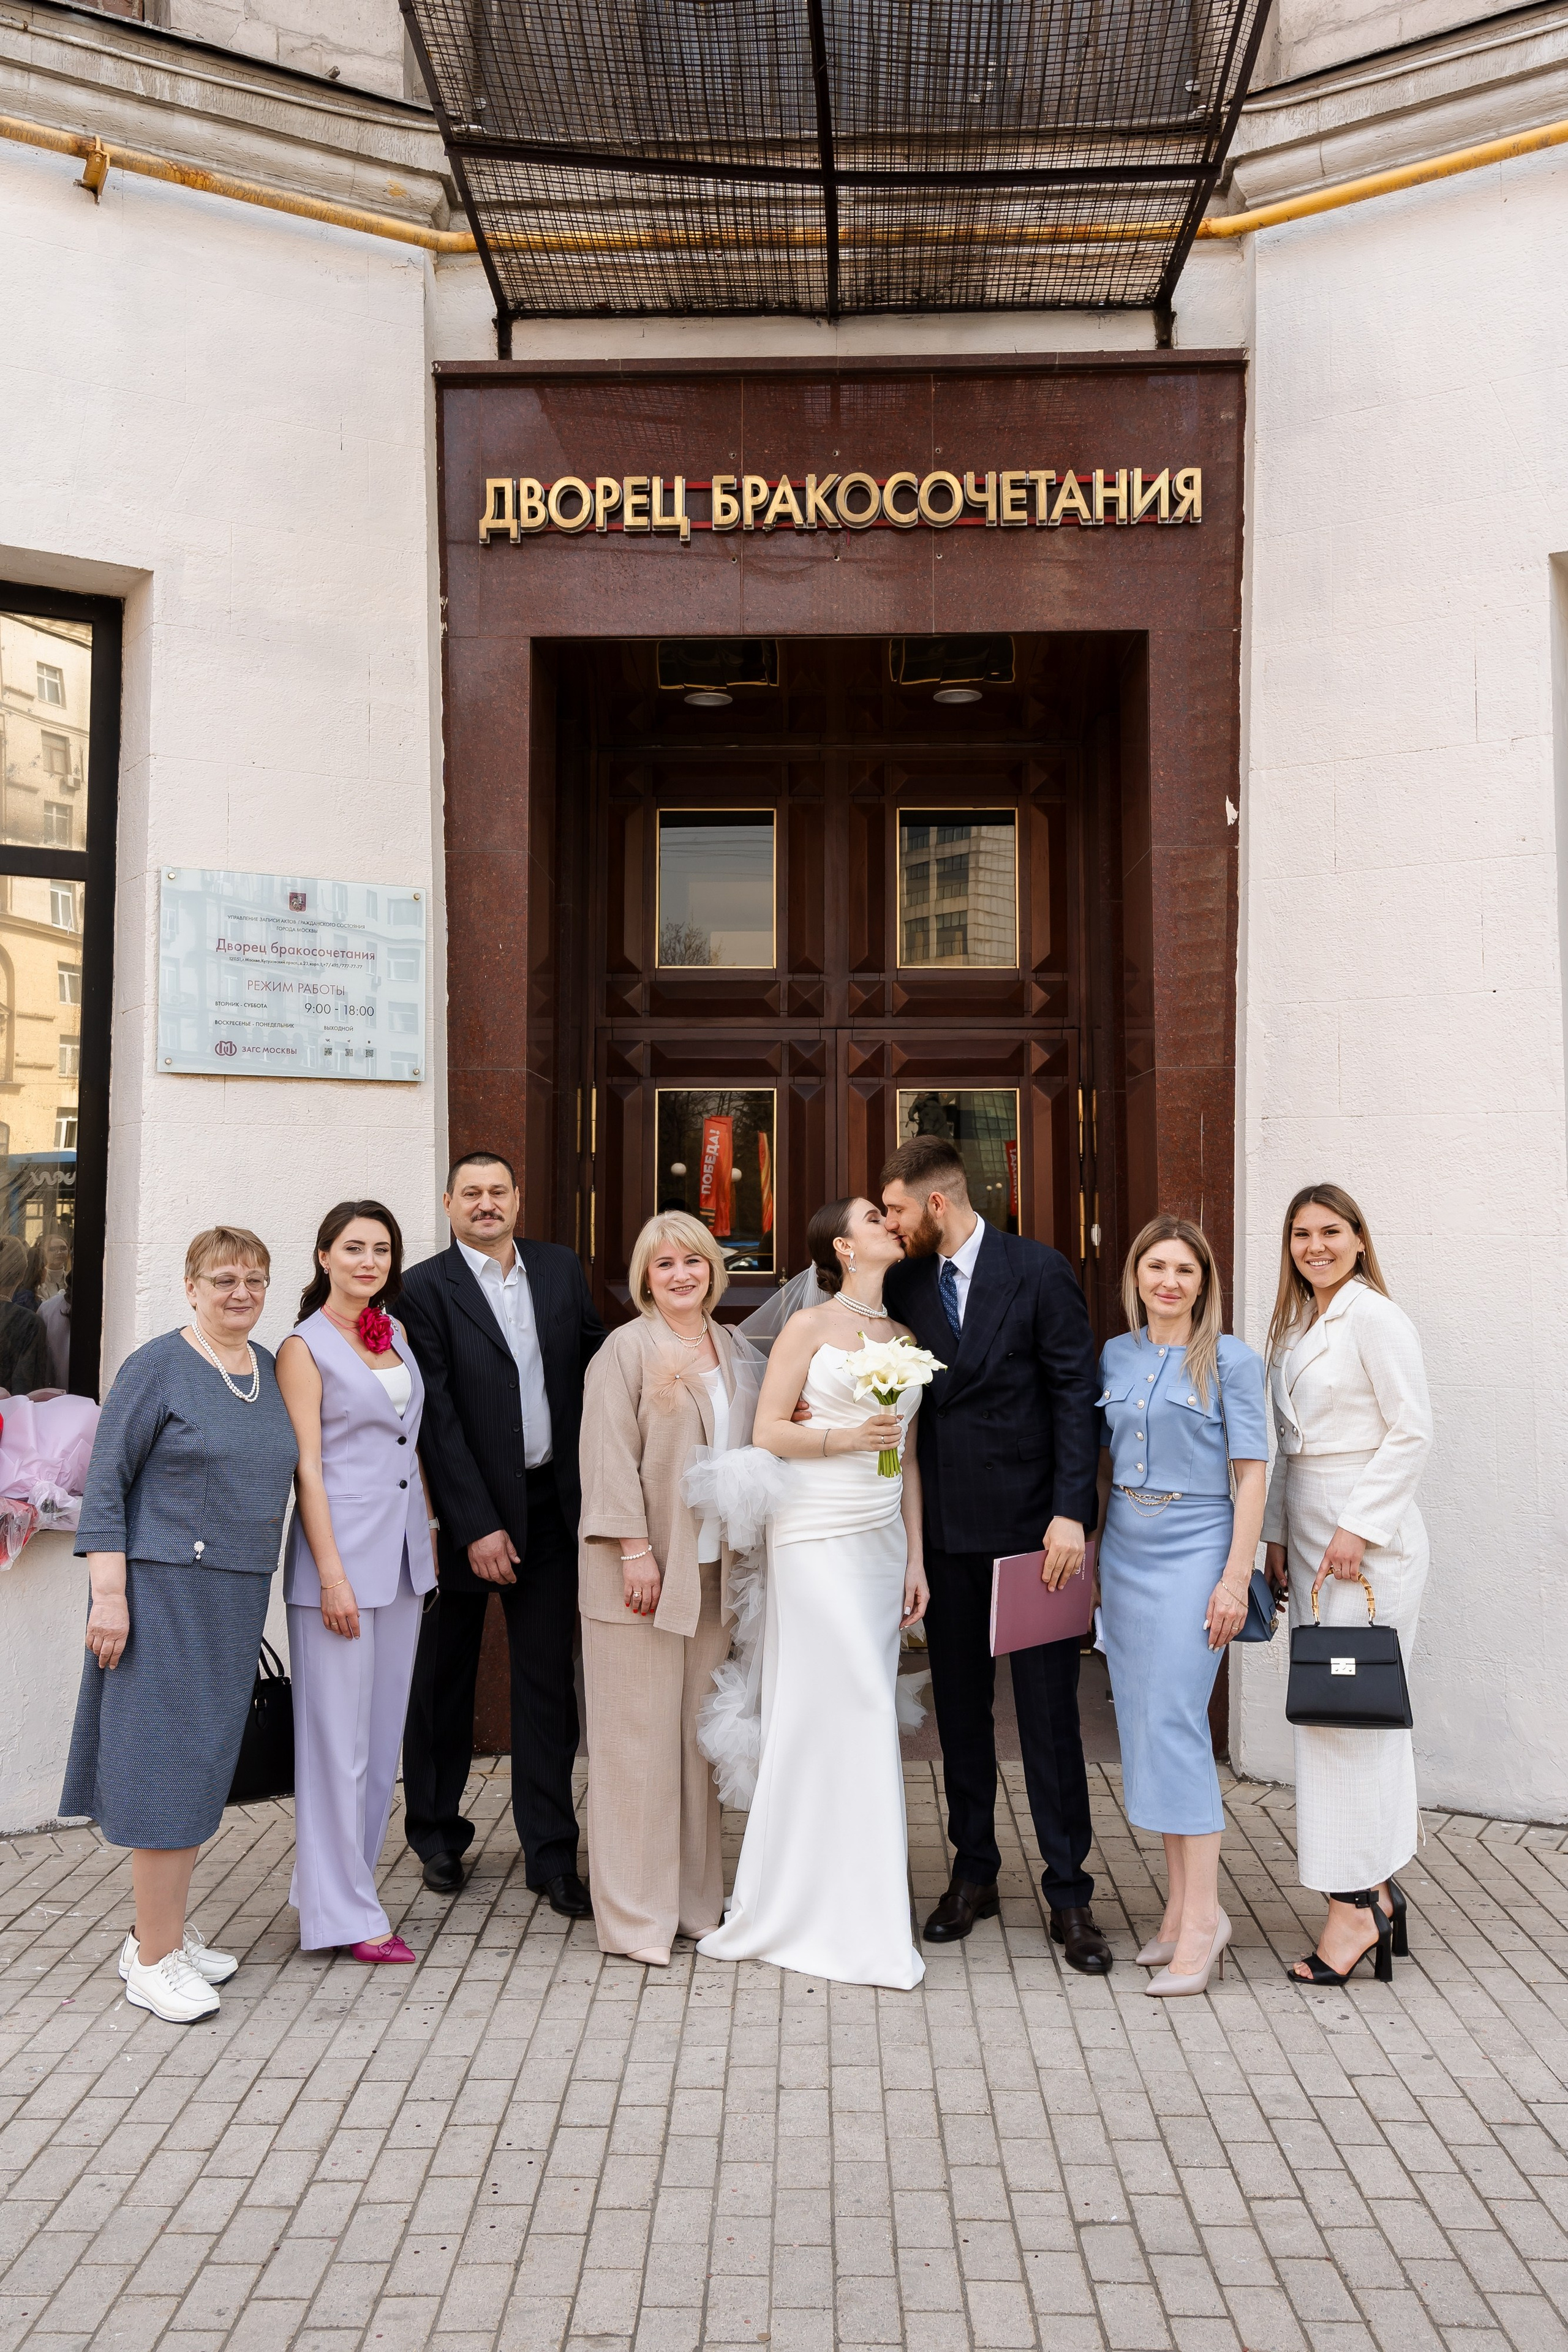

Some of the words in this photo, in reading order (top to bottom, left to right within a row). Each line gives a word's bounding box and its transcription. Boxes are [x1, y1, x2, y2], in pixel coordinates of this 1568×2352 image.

[479, 475, 690, 543] ДВОРЕЦ
[712, 467, 1202, 532] БРАКОСОЧЕТАНИЯ
[216, 938, 266, 955] Дворец
[271, 941, 375, 960] бракосочетания
[247, 980, 293, 992] РЕЖИМ
[298, 983, 345, 995] РАБОТЫ
[304, 1003, 331, 1014] 9:00
[344, 1005, 374, 1016] 18:00
[701, 1129, 720, 1194] ПОБЕДА!
